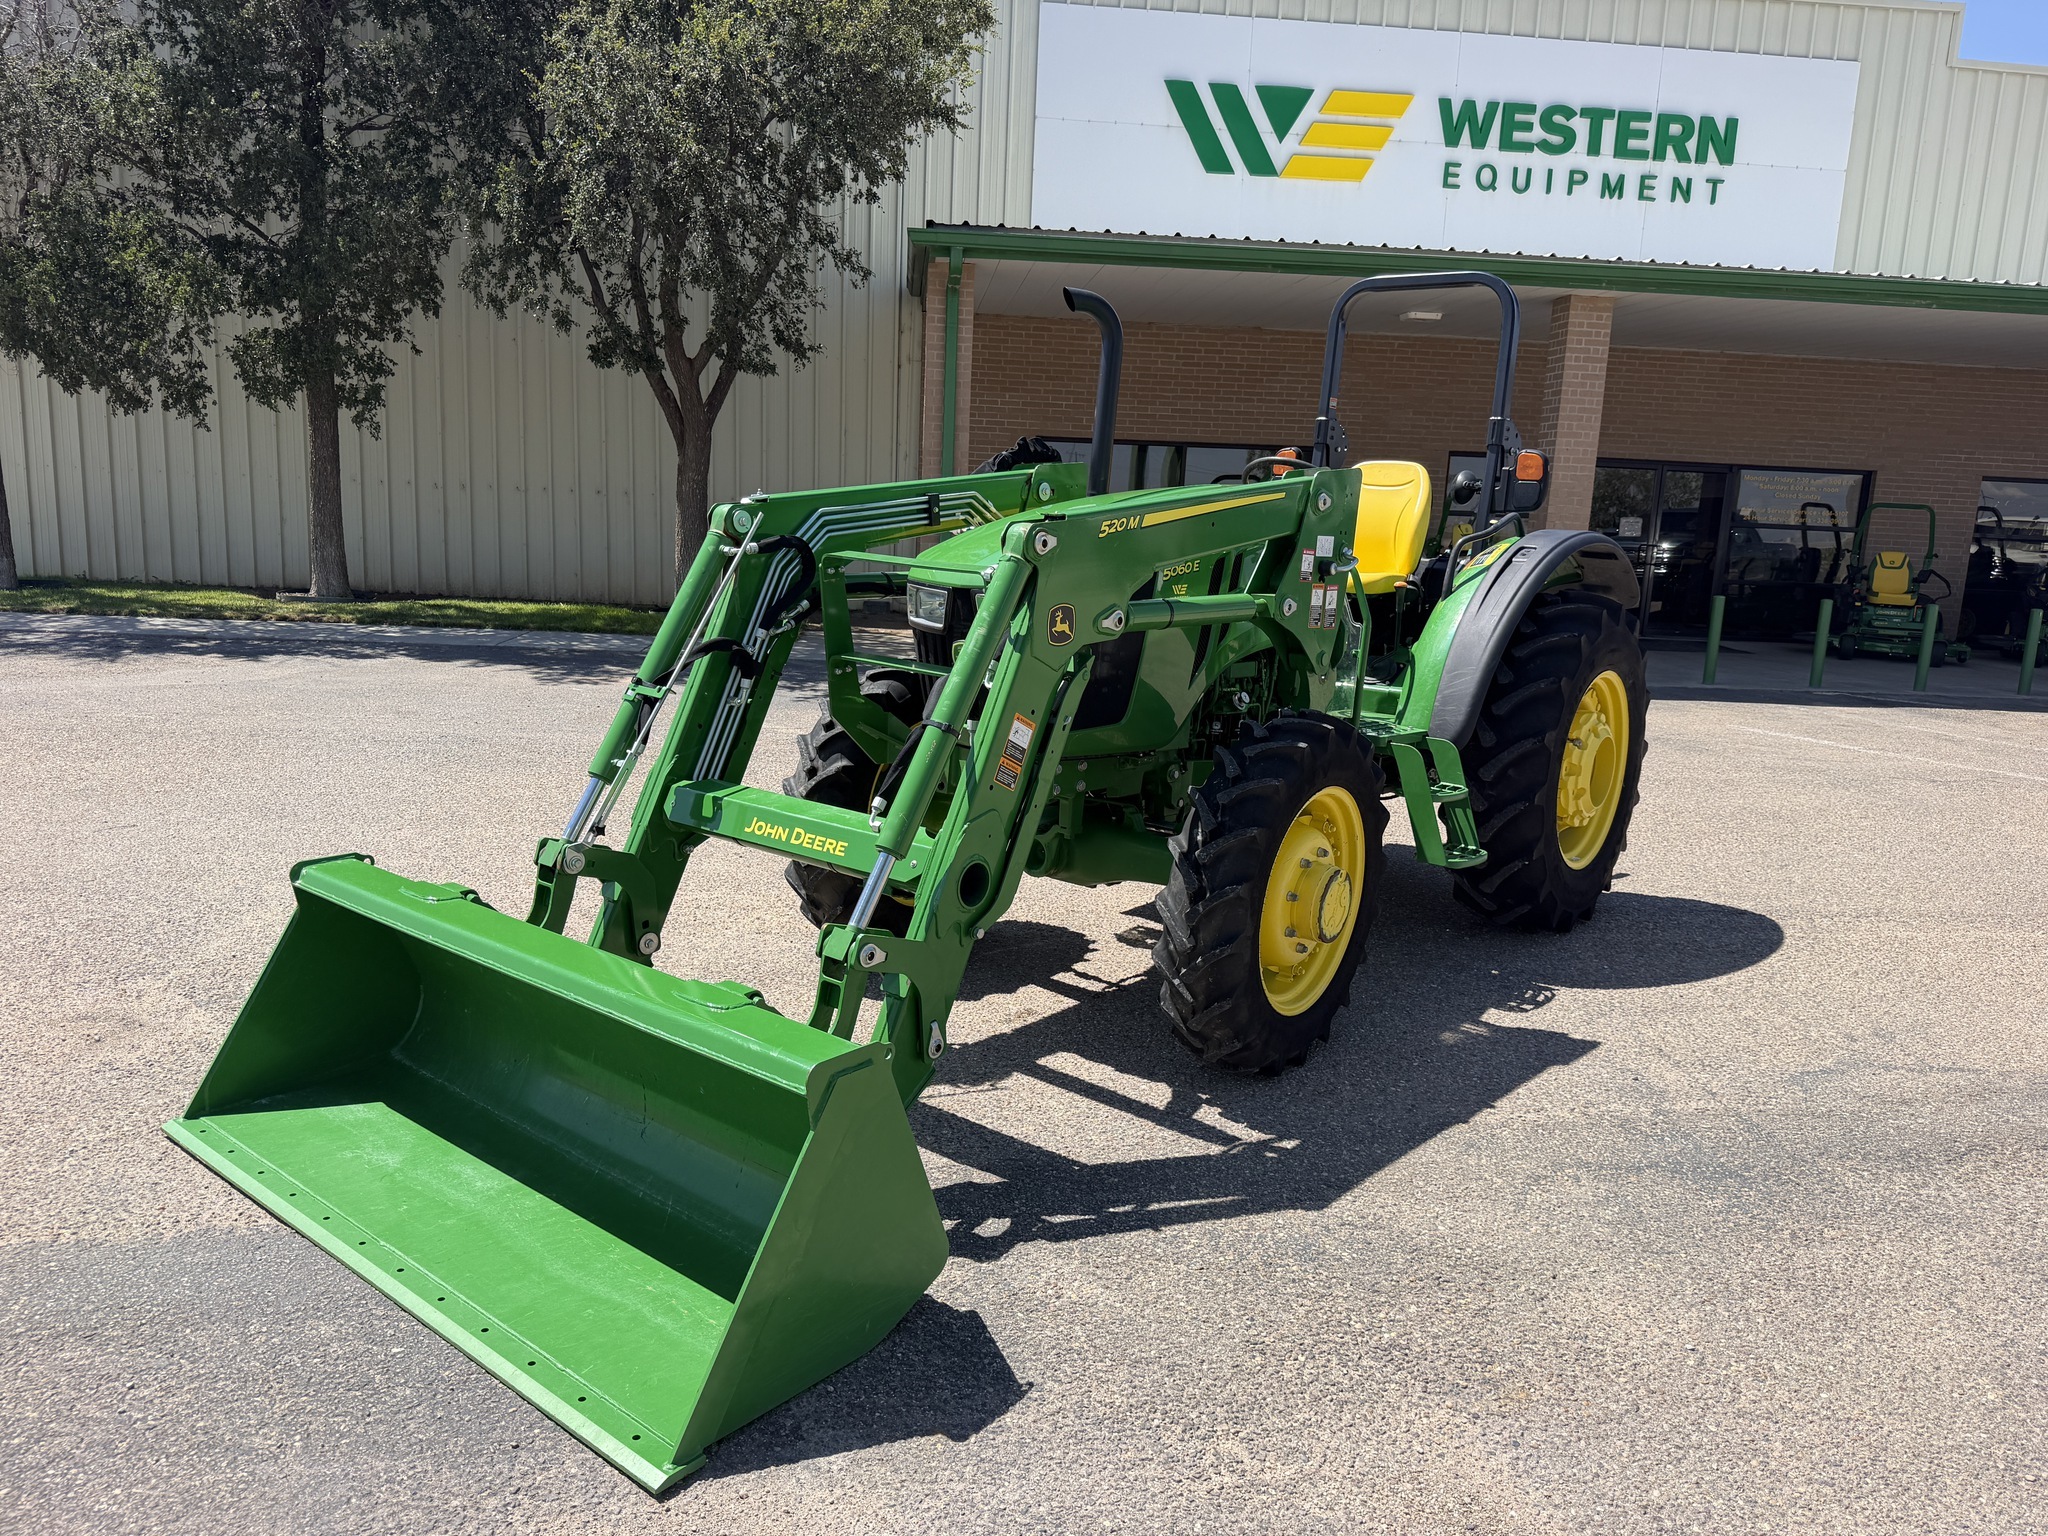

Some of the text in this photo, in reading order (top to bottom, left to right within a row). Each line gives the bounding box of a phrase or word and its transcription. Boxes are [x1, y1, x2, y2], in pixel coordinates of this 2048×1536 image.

[1438, 97, 1739, 166] WESTERN
[1442, 161, 1725, 206] EQUIPMENT
[1743, 474, 1769, 482] Monday
[1759, 483, 1789, 491] Saturday:
[1098, 515, 1141, 538] 520 M
[1162, 560, 1201, 581] 5060 E
[744, 816, 849, 857] JOHN DEERE
